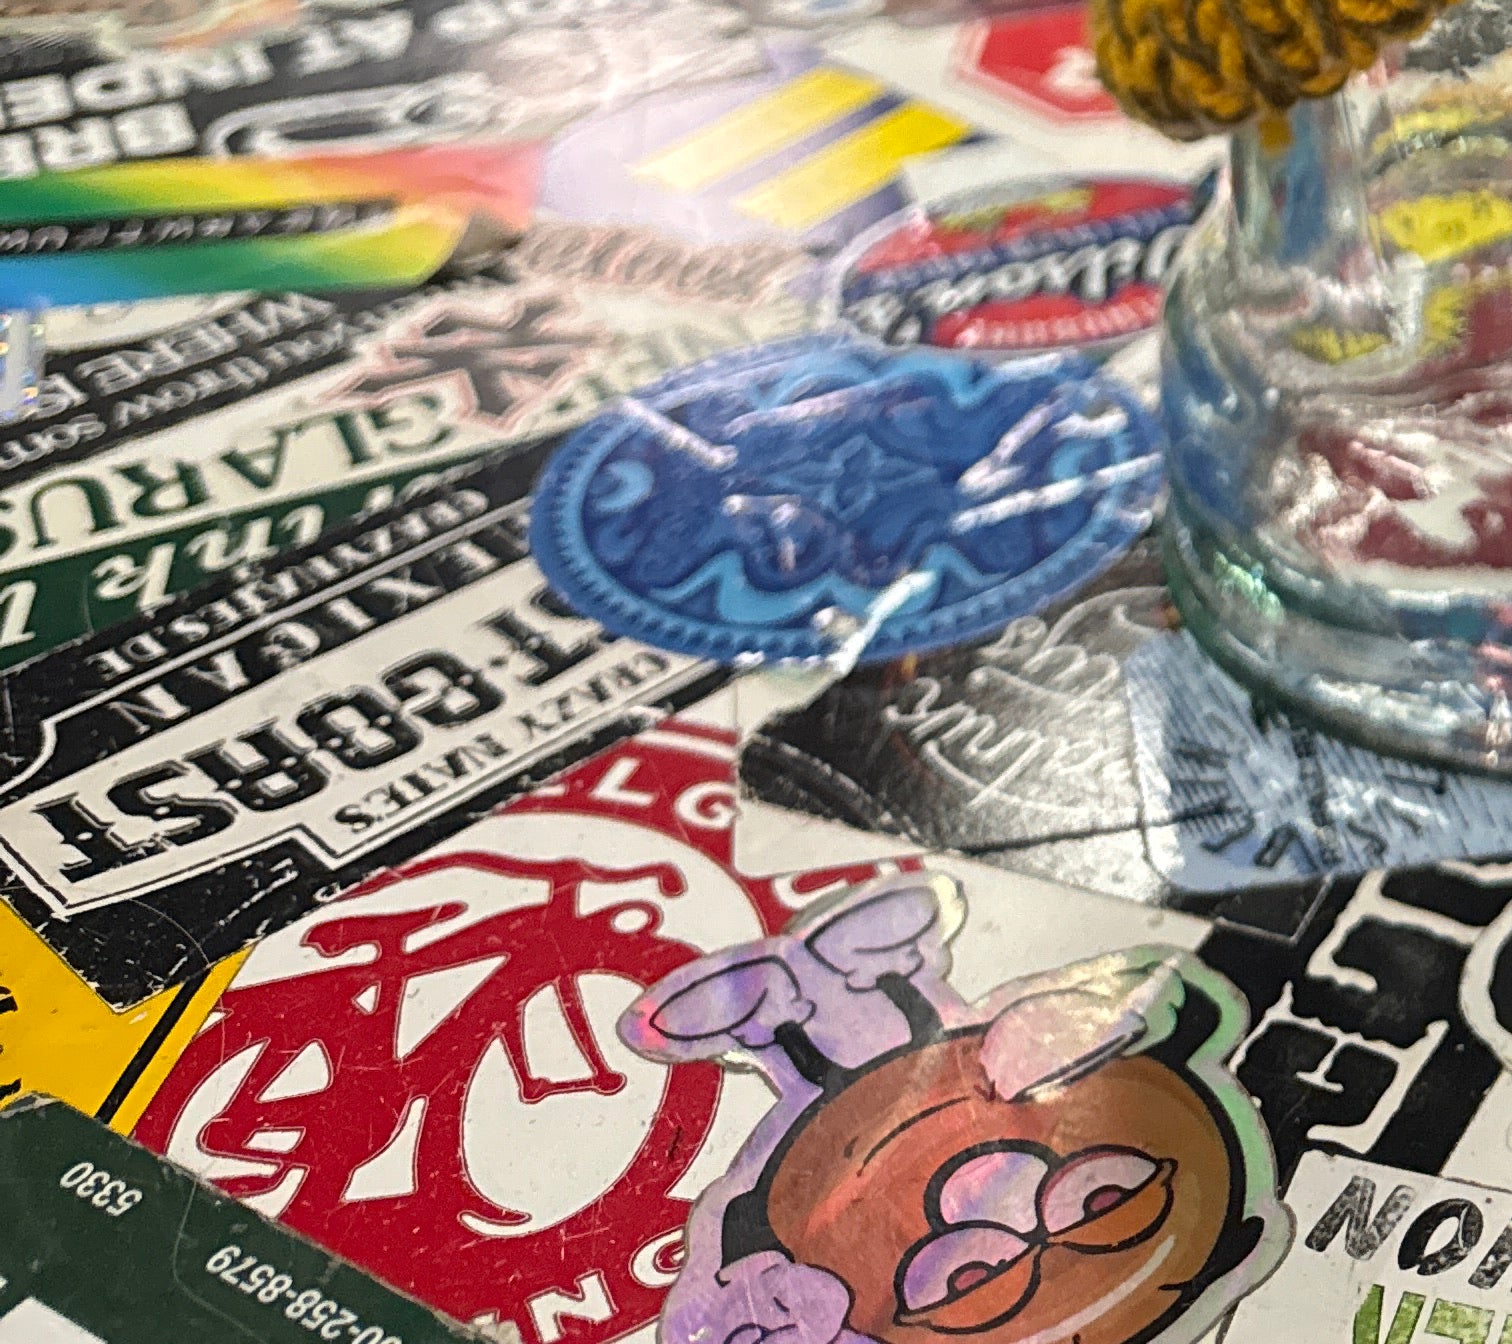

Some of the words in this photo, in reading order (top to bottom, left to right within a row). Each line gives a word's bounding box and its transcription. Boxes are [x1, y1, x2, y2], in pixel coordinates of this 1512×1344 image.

[0, 42, 272, 126] INDE
[83, 293, 334, 388] WHERE
[119, 357, 268, 421] throw
[519, 655, 672, 734] CRAZY
[338, 736, 512, 833] NATE'S
[60, 1161, 143, 1216] 5330
